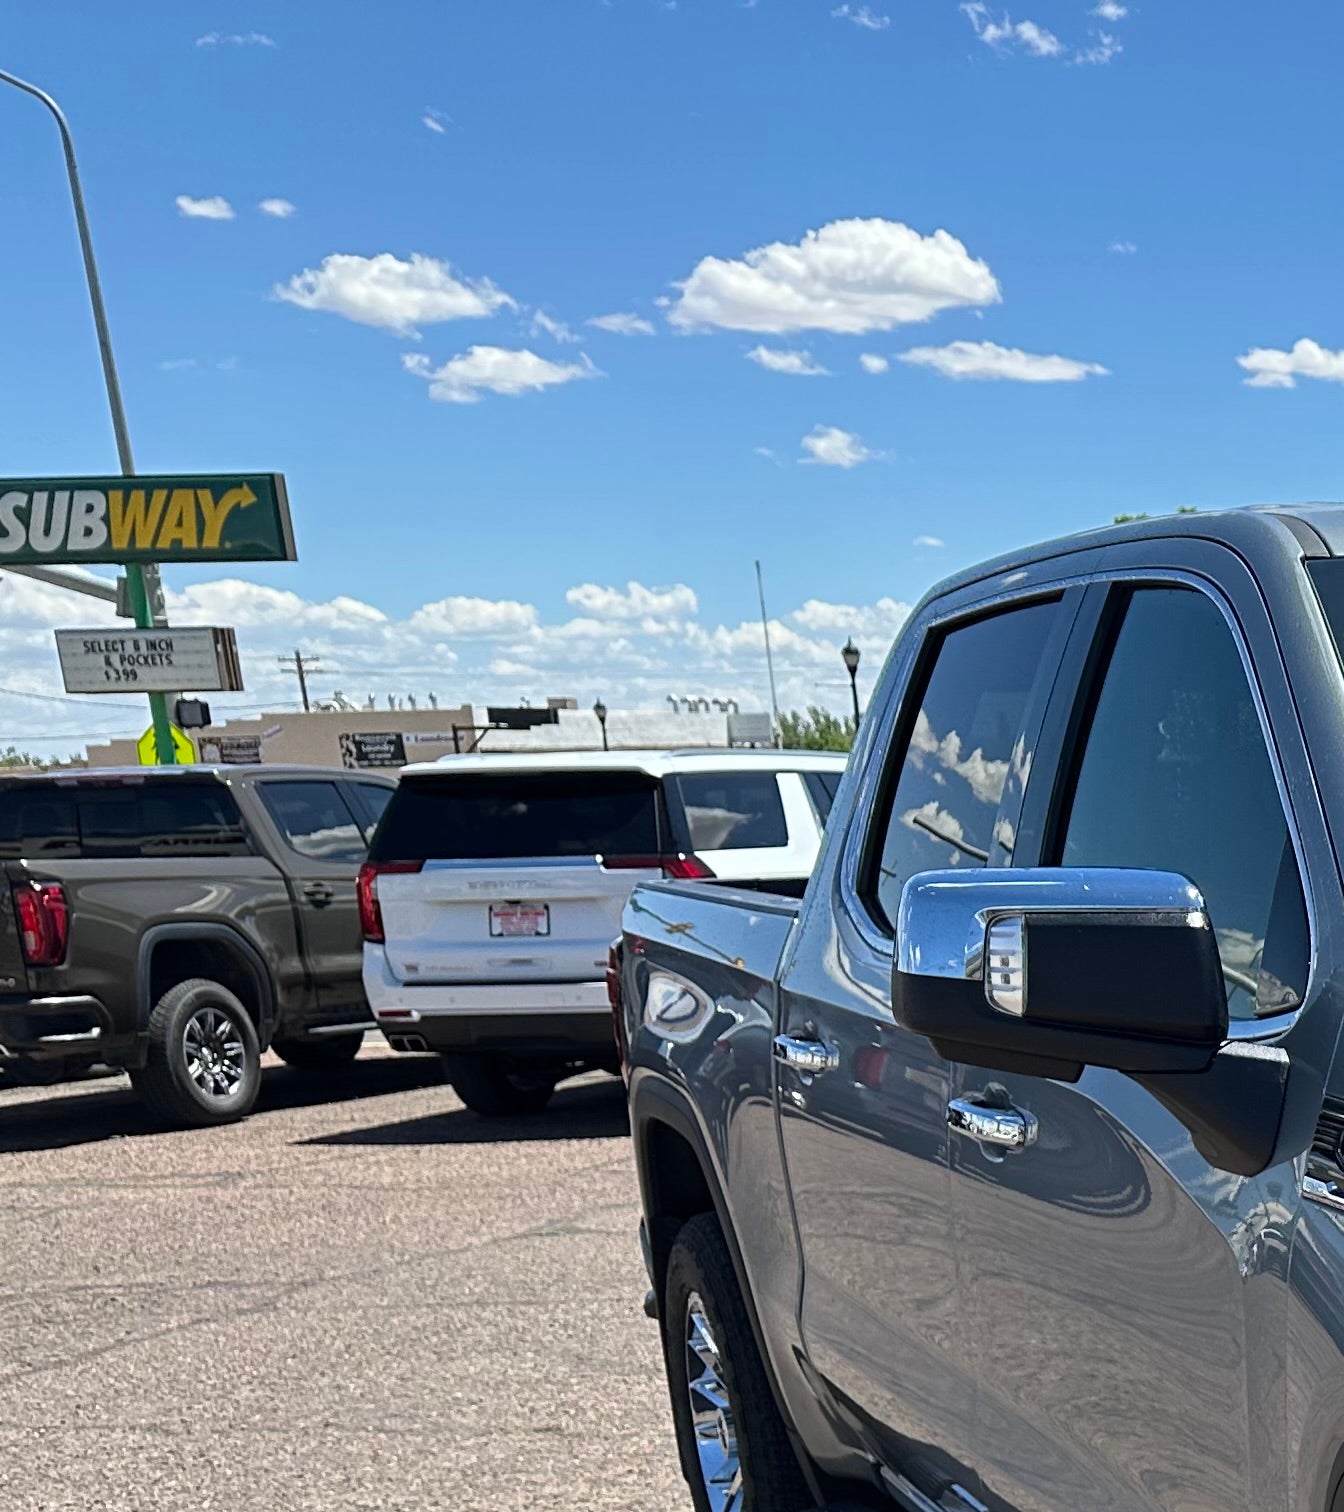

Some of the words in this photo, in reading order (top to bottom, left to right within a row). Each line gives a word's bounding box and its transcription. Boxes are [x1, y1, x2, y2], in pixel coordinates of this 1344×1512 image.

[0, 482, 257, 553] SUBWAY
[83, 640, 126, 653] SELECT
[146, 638, 174, 652] INCH
[120, 653, 173, 667] POCKETS
